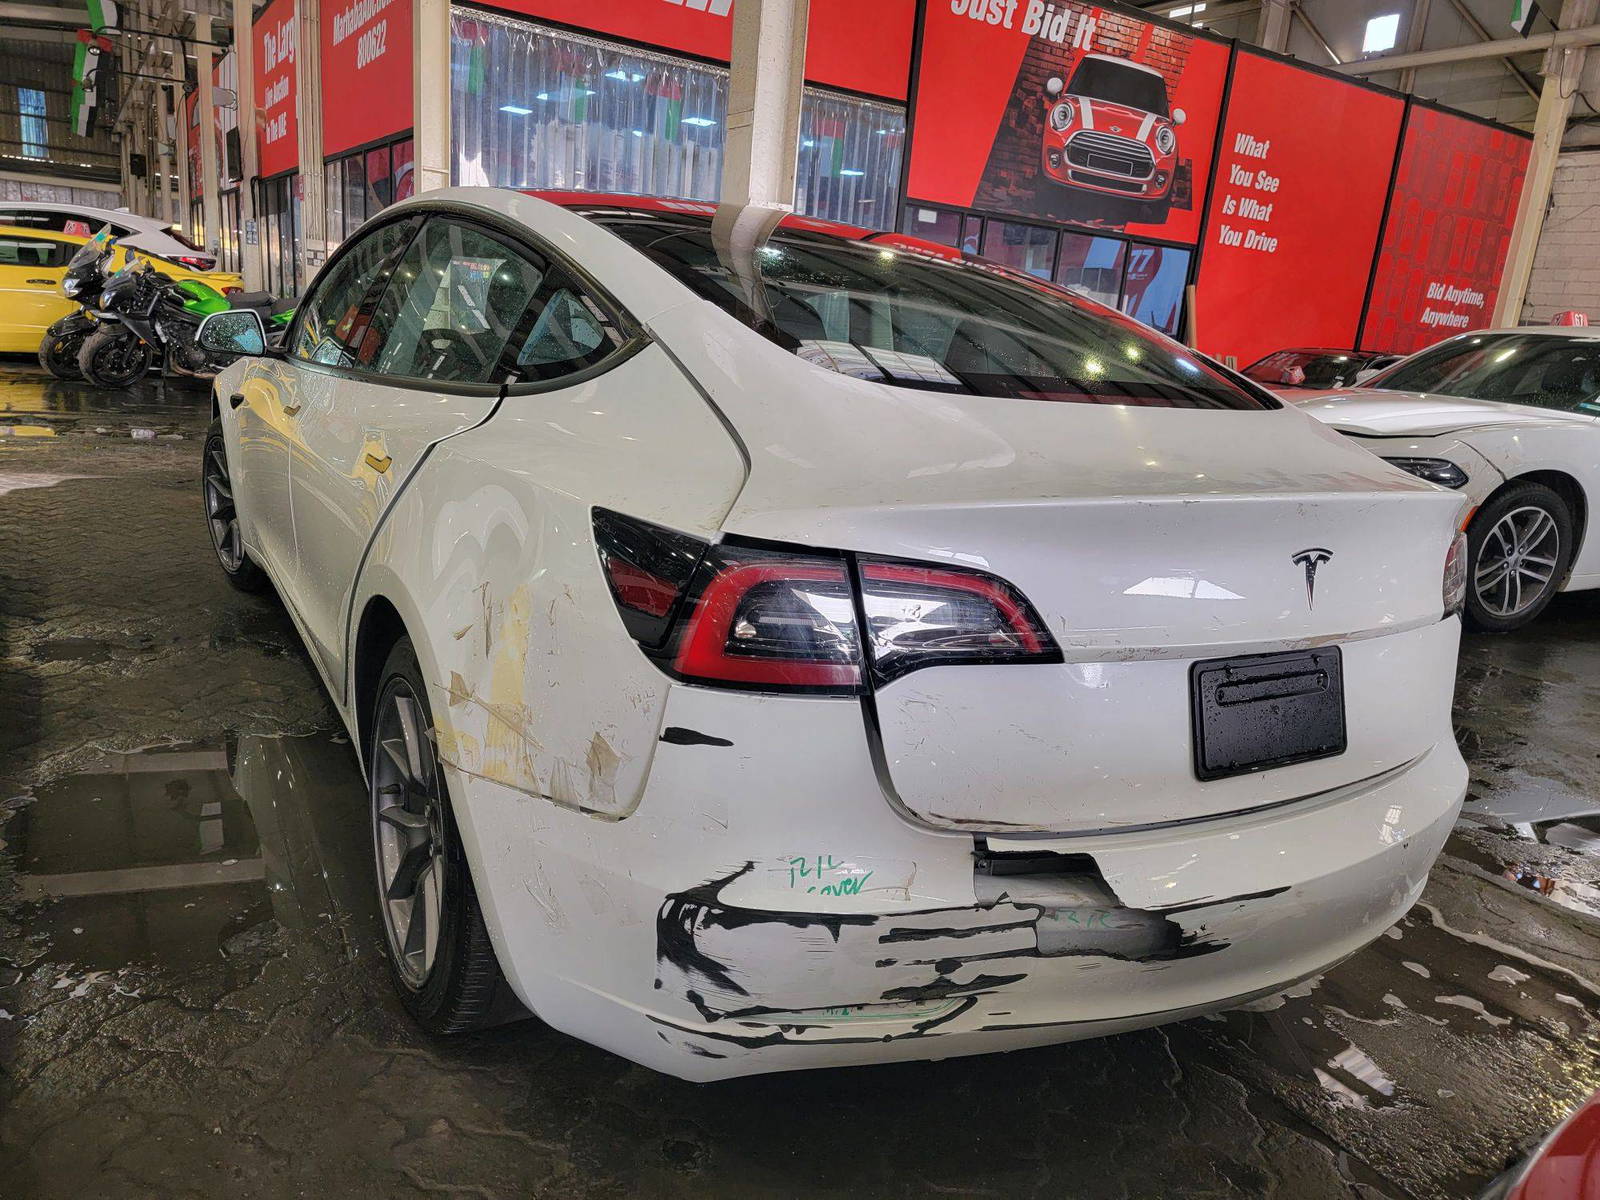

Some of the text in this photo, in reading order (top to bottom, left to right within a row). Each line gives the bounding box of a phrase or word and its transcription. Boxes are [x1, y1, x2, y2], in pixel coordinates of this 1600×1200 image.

[1021, 0, 1072, 43] Bid
[1072, 14, 1097, 51] It
[264, 31, 276, 75] The
[357, 18, 387, 70] 800622
[1234, 132, 1270, 160] What
[1229, 163, 1280, 193] You See
[1222, 195, 1273, 222] Is What
[1219, 224, 1278, 253] You Drive
[1426, 281, 1485, 309] Bid Anytime,
[1420, 307, 1470, 329] Anywhere
